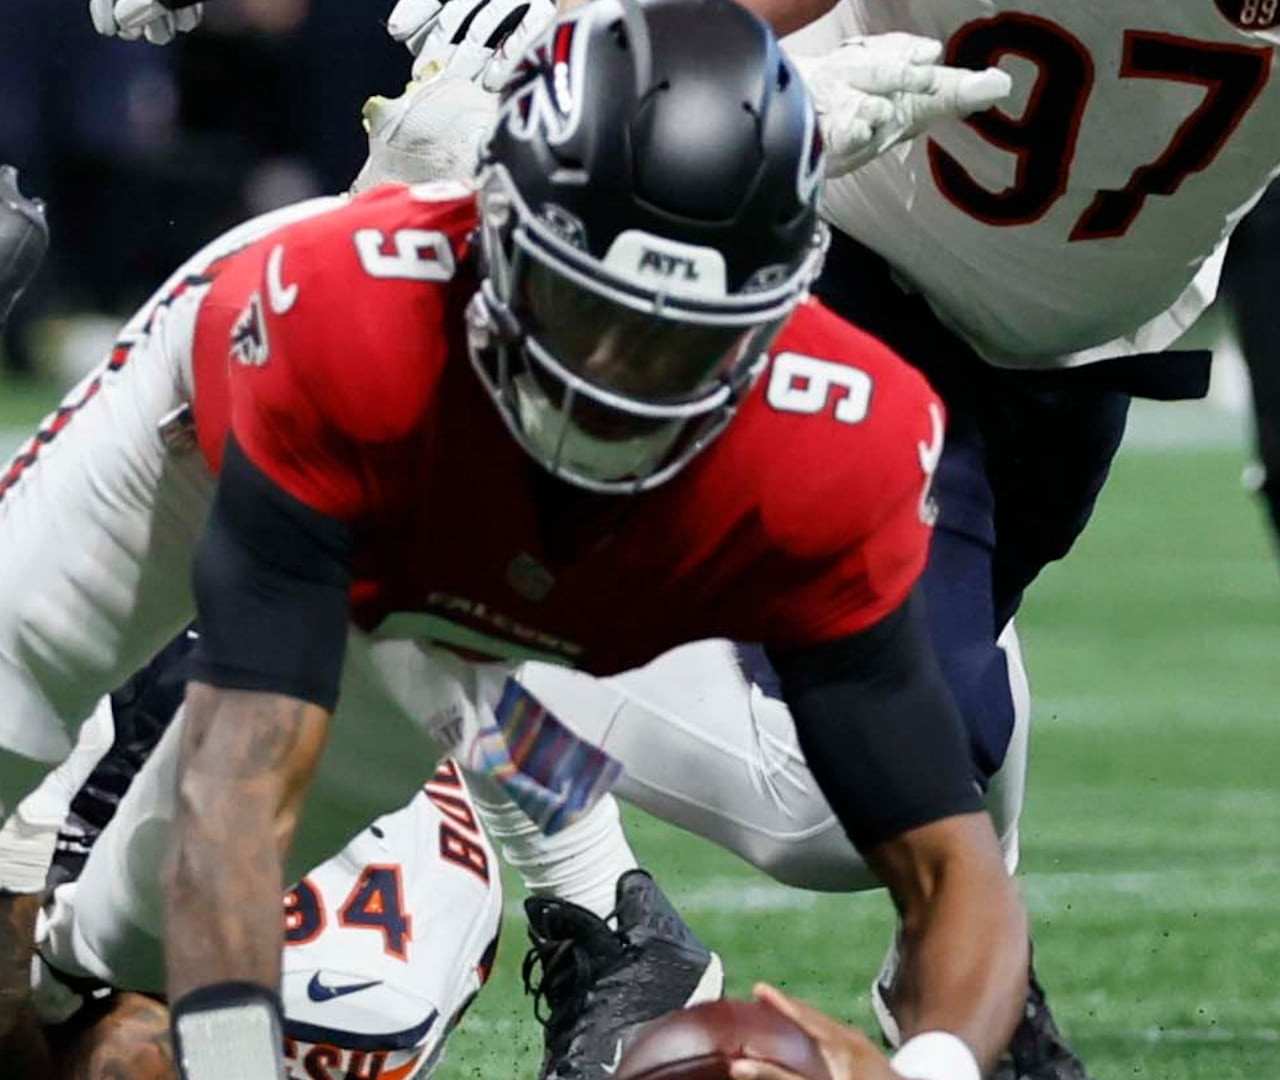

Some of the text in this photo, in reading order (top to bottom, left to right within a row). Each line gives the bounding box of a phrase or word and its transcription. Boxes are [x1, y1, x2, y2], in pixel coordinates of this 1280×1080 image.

[927, 10, 1275, 243] 97
[353, 228, 457, 283] 9
[638, 247, 700, 281] ATL
[766, 351, 873, 425] 9
